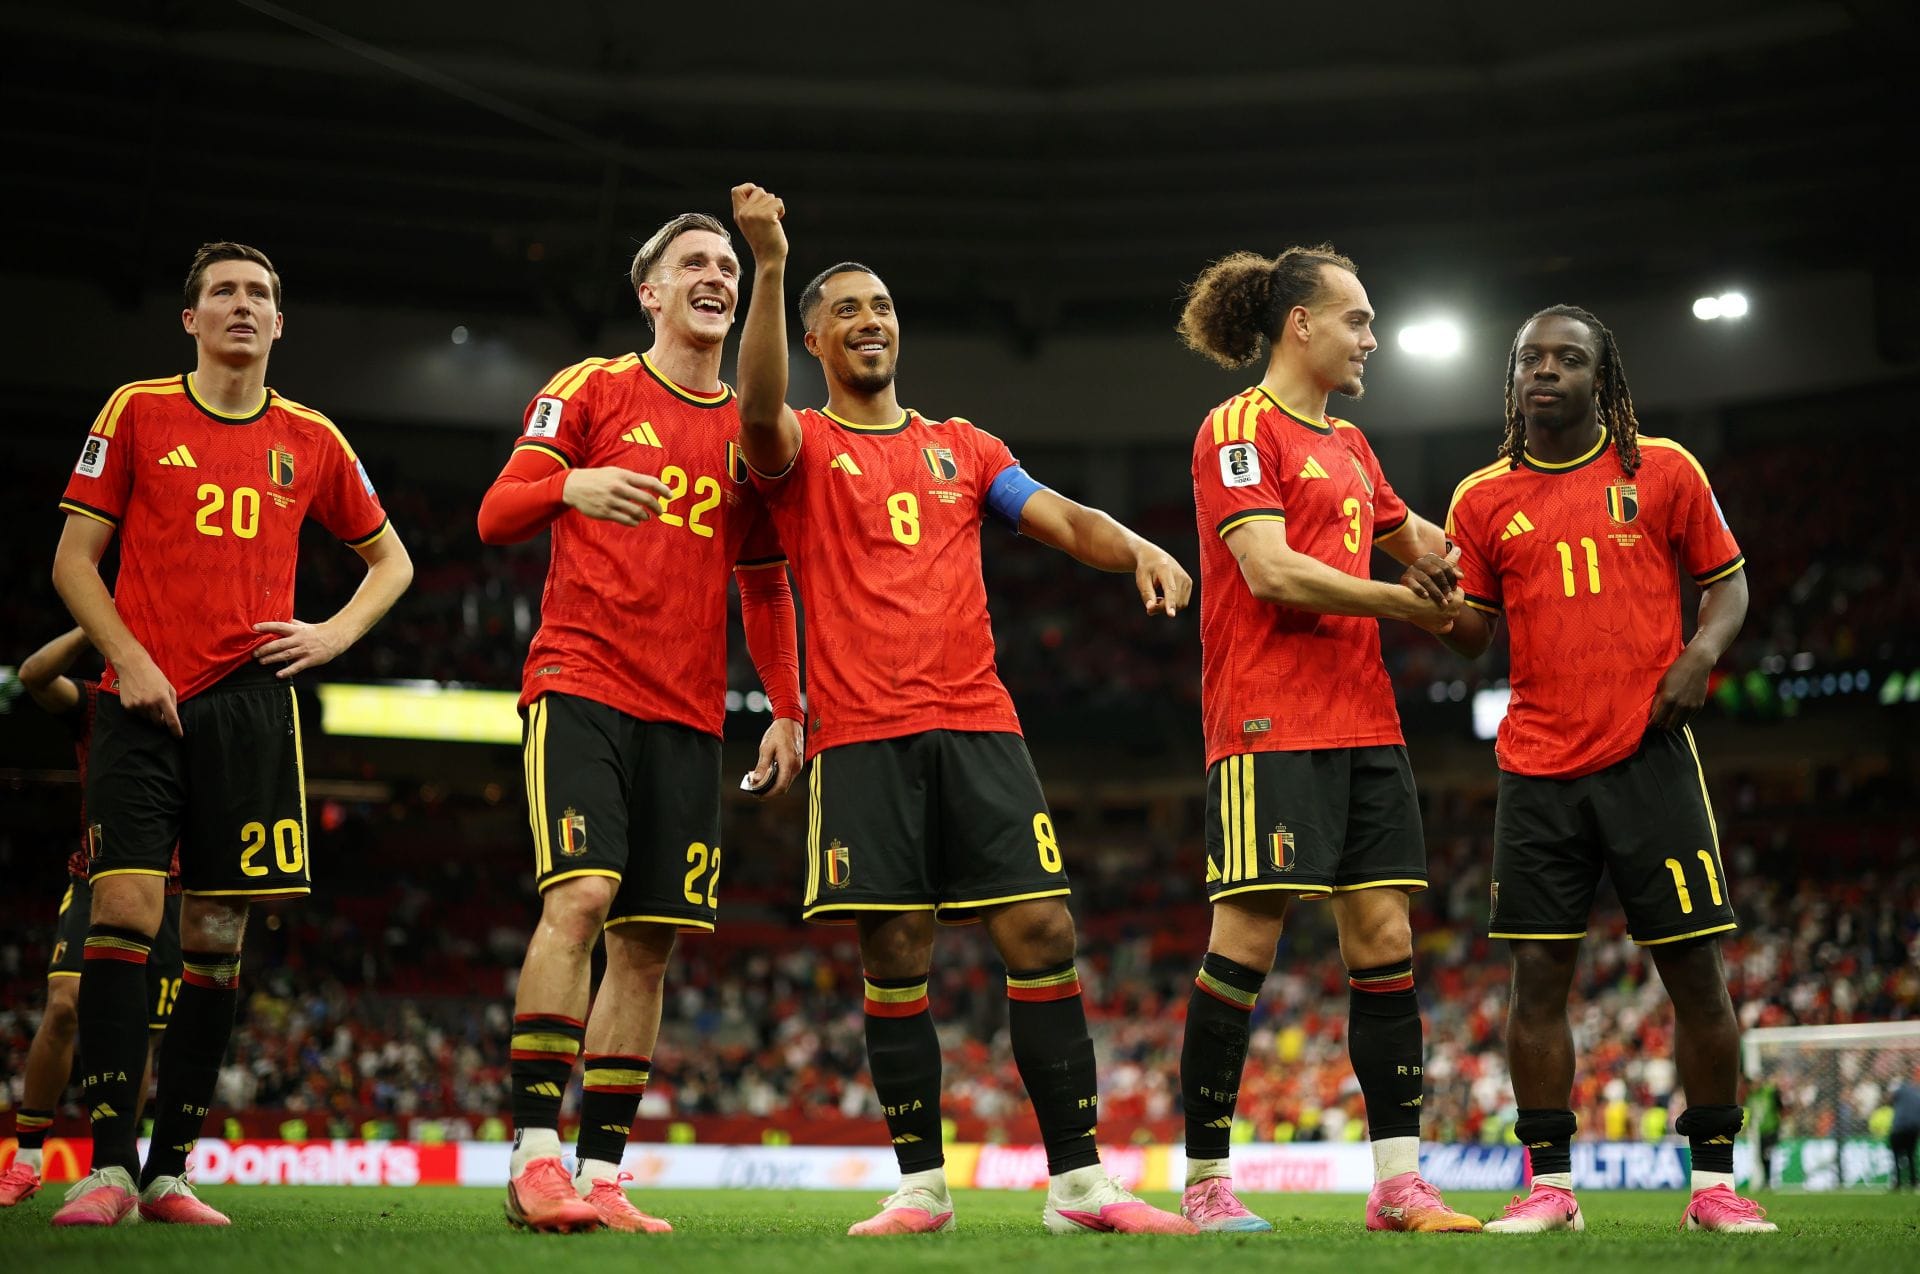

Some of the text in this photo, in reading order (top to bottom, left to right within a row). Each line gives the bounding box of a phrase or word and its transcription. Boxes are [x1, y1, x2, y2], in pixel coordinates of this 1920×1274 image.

[196, 484, 260, 539] 20
[657, 465, 721, 538] 22
[887, 493, 920, 546] 8
[1342, 497, 1361, 554] 3
[1556, 537, 1601, 598] 11
[240, 818, 304, 877] 20
[1032, 812, 1063, 874] 8
[684, 841, 721, 909] 22
[1664, 849, 1723, 914] 11
[1397, 1065, 1424, 1076] RB
[182, 1103, 209, 1117] RB
[186, 1139, 419, 1186] Donald's
